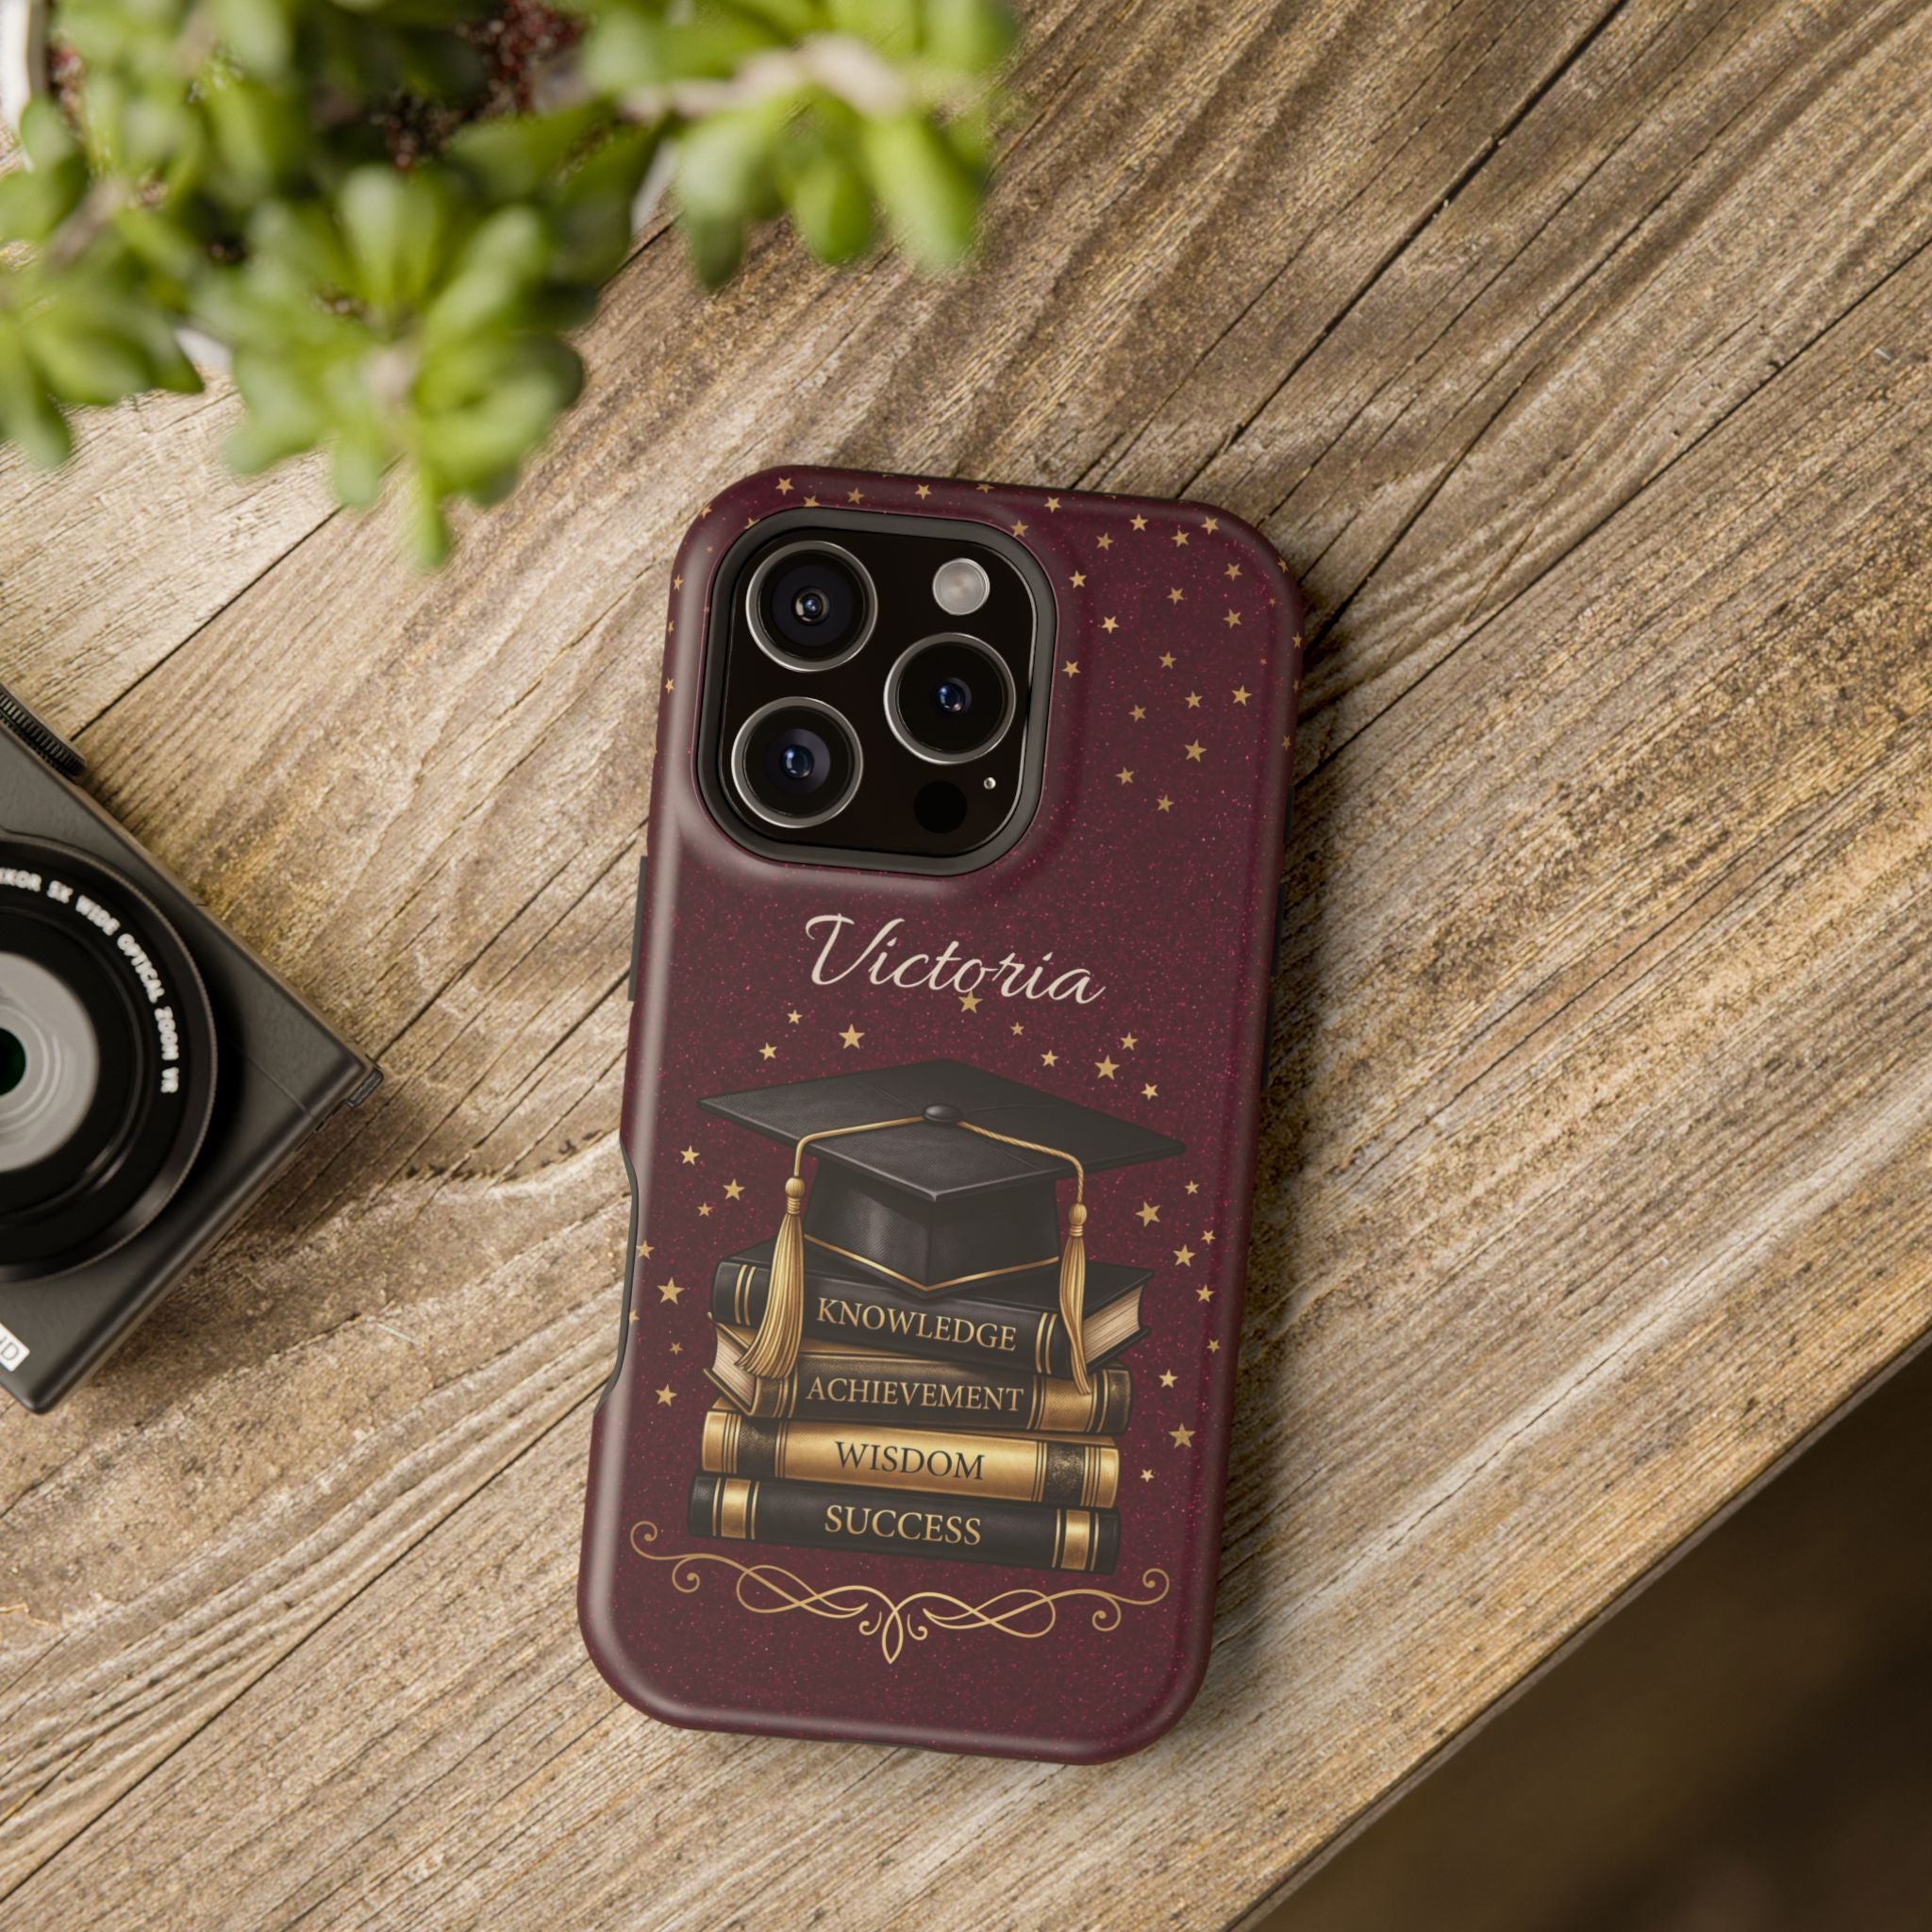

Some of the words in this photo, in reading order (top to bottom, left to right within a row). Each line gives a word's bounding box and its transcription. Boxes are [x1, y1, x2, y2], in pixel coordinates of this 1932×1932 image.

[75, 894, 121, 937] WIDE
[117, 933, 165, 1004] OPTICAL
[154, 1006, 179, 1061] ZOOM
[805, 912, 1107, 1005] Victoria
[816, 1297, 1017, 1352] KNOWLEDGE
[806, 1376, 1024, 1412] ACHIEVEMENT
[835, 1441, 986, 1480] WISDOM
[824, 1505, 982, 1546] SUCCESS
